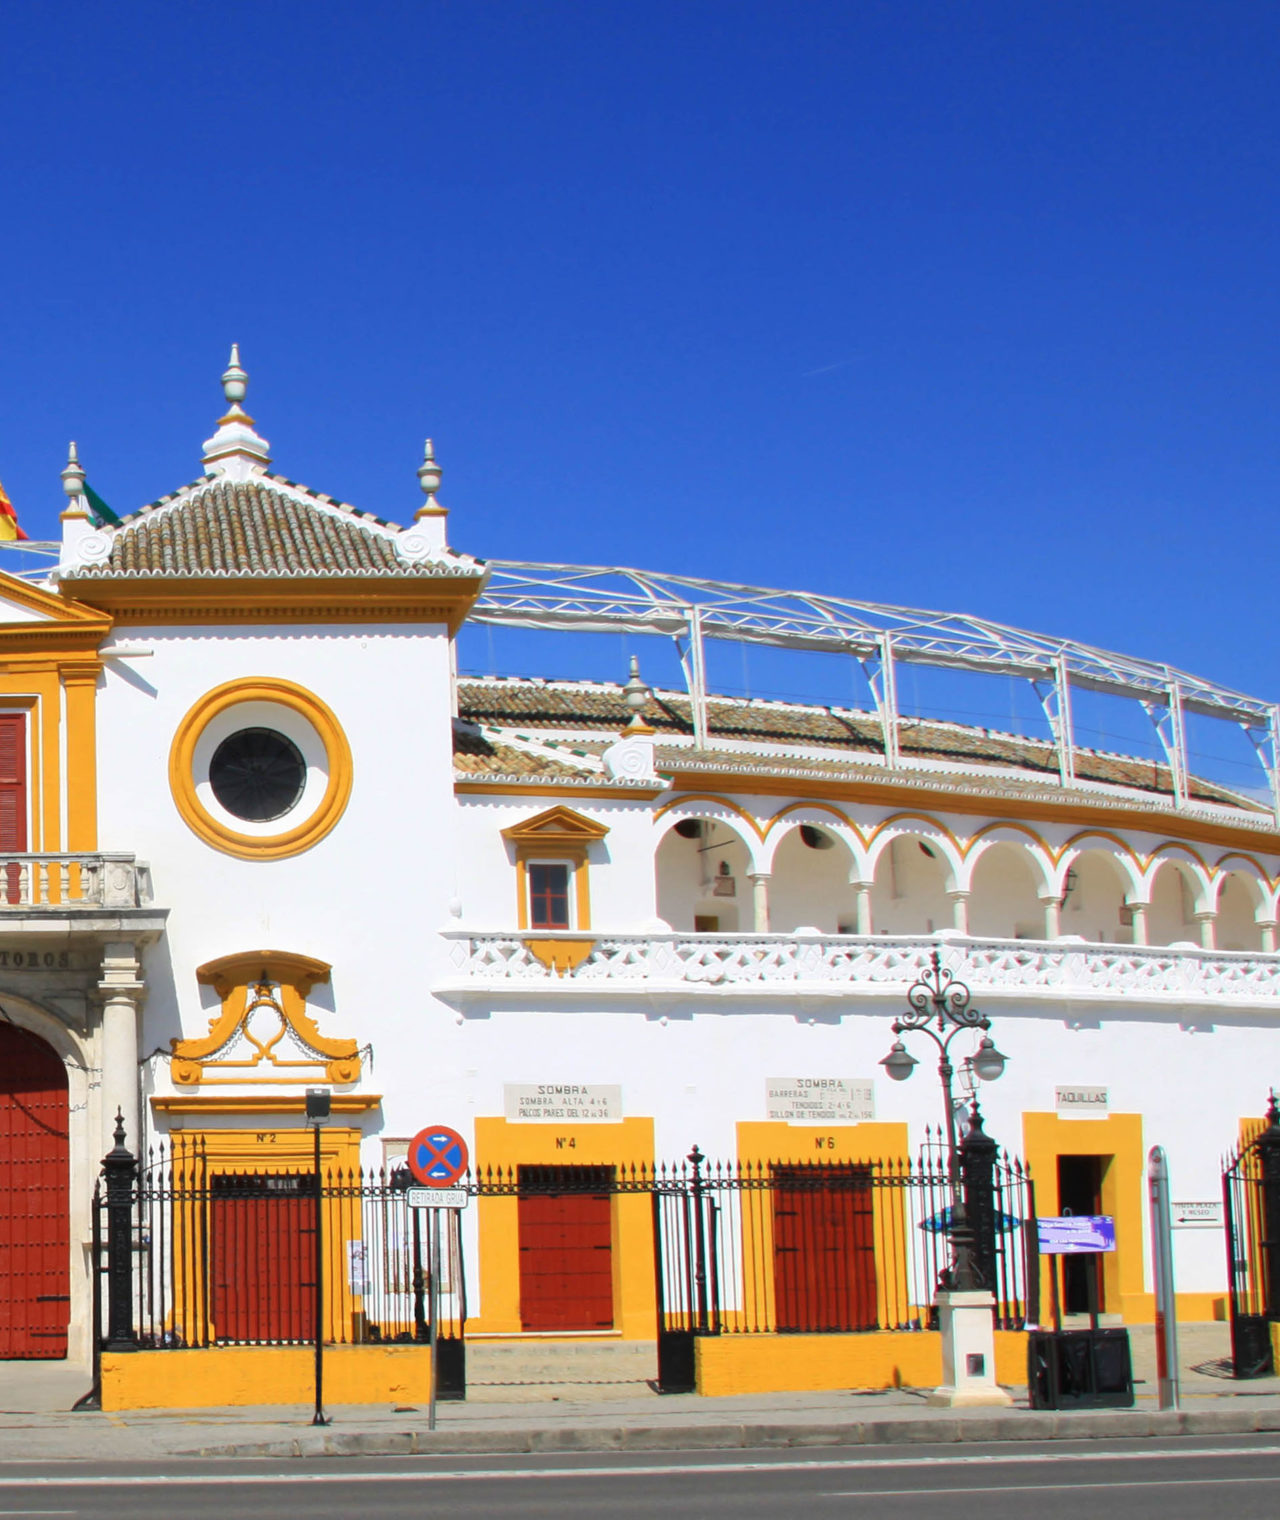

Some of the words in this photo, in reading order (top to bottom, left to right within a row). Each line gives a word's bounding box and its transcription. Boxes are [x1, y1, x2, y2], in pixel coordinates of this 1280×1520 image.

[0, 951, 70, 968] TOROS
[797, 1079, 844, 1089] SOMBRA
[538, 1085, 588, 1095] SOMBRA
[769, 1090, 809, 1098] BARRERAS
[519, 1096, 554, 1106] SOMBRA
[562, 1097, 584, 1106] ALTA
[1055, 1091, 1107, 1104] TAQUILLAS
[791, 1101, 823, 1110] TENDIDOS
[519, 1108, 541, 1118] PALCOS
[543, 1108, 565, 1118] PARES
[567, 1108, 579, 1118] DEL
[582, 1108, 590, 1118] 12
[599, 1108, 609, 1118] 36
[796, 1110, 806, 1119] DE
[270, 1132, 277, 1143] 2
[568, 1136, 576, 1149] 4
[827, 1136, 835, 1149] 6
[411, 1191, 444, 1204] RETIRADA
